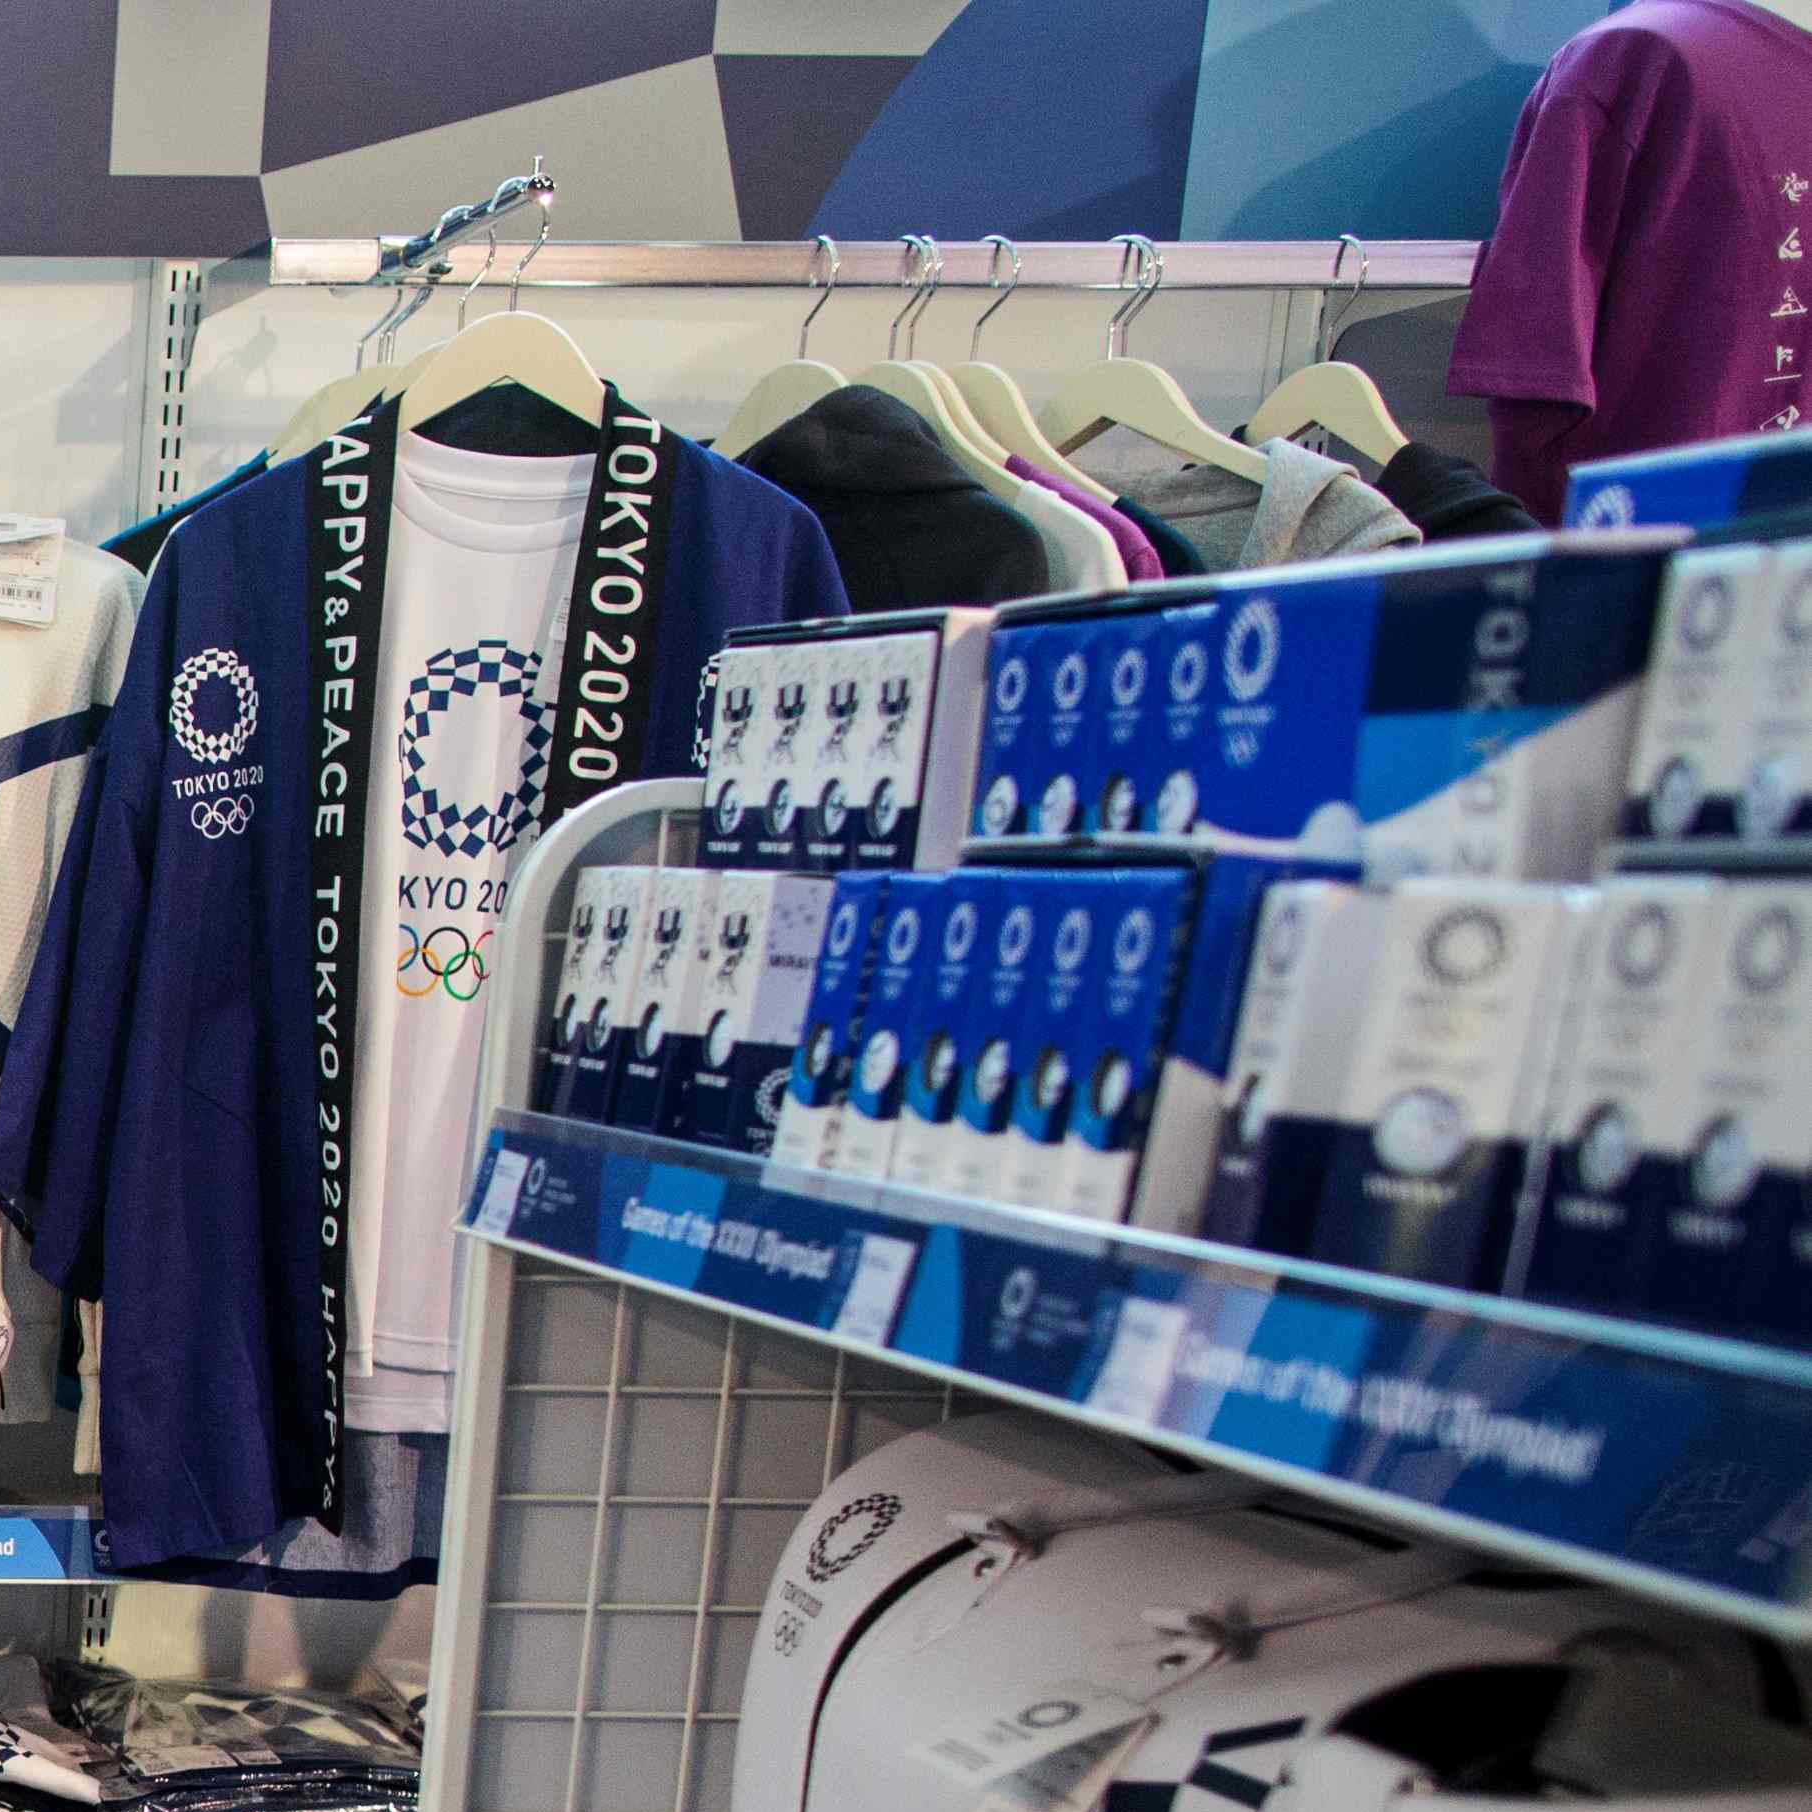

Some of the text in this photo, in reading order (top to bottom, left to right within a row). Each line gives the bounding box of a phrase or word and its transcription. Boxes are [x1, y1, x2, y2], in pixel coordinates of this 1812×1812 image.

[569, 411, 662, 783] TOKYO 2020
[171, 765, 265, 800] TOKYO 2020
[398, 876, 508, 915] KYO 20
[315, 874, 342, 1080] TOKYO
[317, 1100, 342, 1249] 2020
[620, 1197, 667, 1239] Games
[667, 1211, 692, 1242] of
[686, 1213, 716, 1250] the
[755, 1228, 836, 1281] Olympiad
